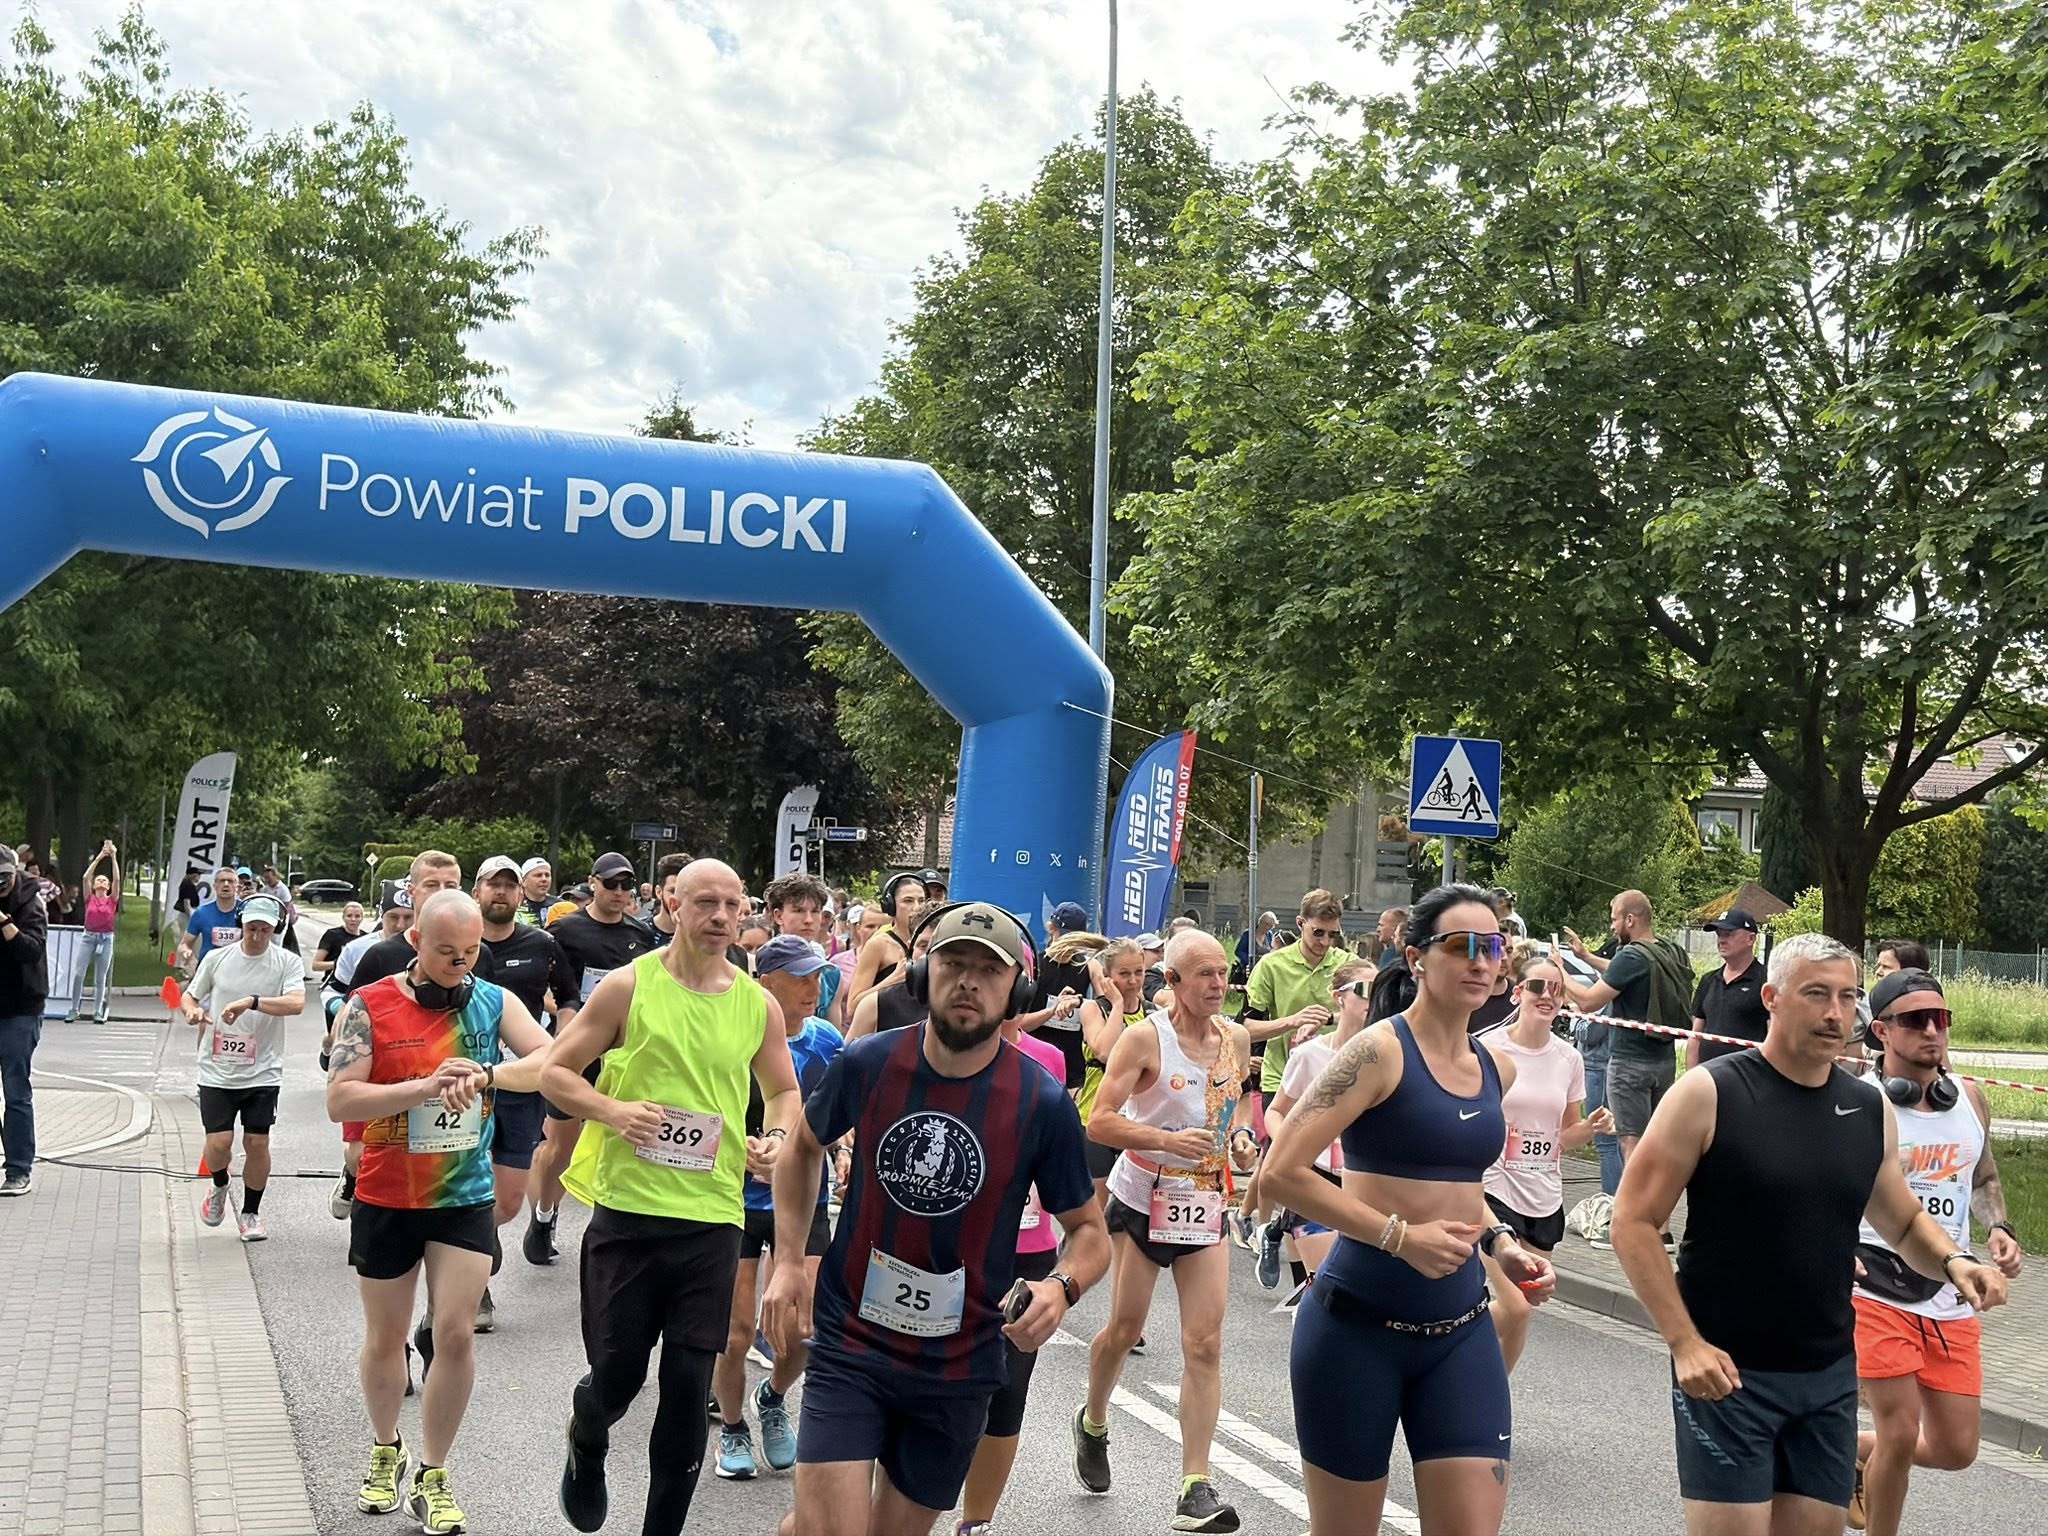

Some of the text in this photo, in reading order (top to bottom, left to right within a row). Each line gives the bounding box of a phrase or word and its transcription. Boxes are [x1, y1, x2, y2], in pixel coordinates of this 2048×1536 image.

[319, 453, 847, 554] Powiat POLICKI
[1179, 763, 1190, 780] 07
[191, 777, 218, 787] POLICE
[1178, 783, 1189, 800] 00
[1151, 766, 1174, 853] TRANS
[1176, 800, 1187, 817] 49
[1123, 793, 1148, 925] HED MED
[218, 932, 235, 940] 338
[222, 1040, 246, 1053] 392
[434, 1111, 461, 1130] 42
[658, 1122, 703, 1147] 369
[1521, 1140, 1551, 1156] 389
[1907, 1143, 1960, 1172] NIKE
[1167, 1205, 1205, 1224] 312
[895, 1283, 931, 1311] 25
